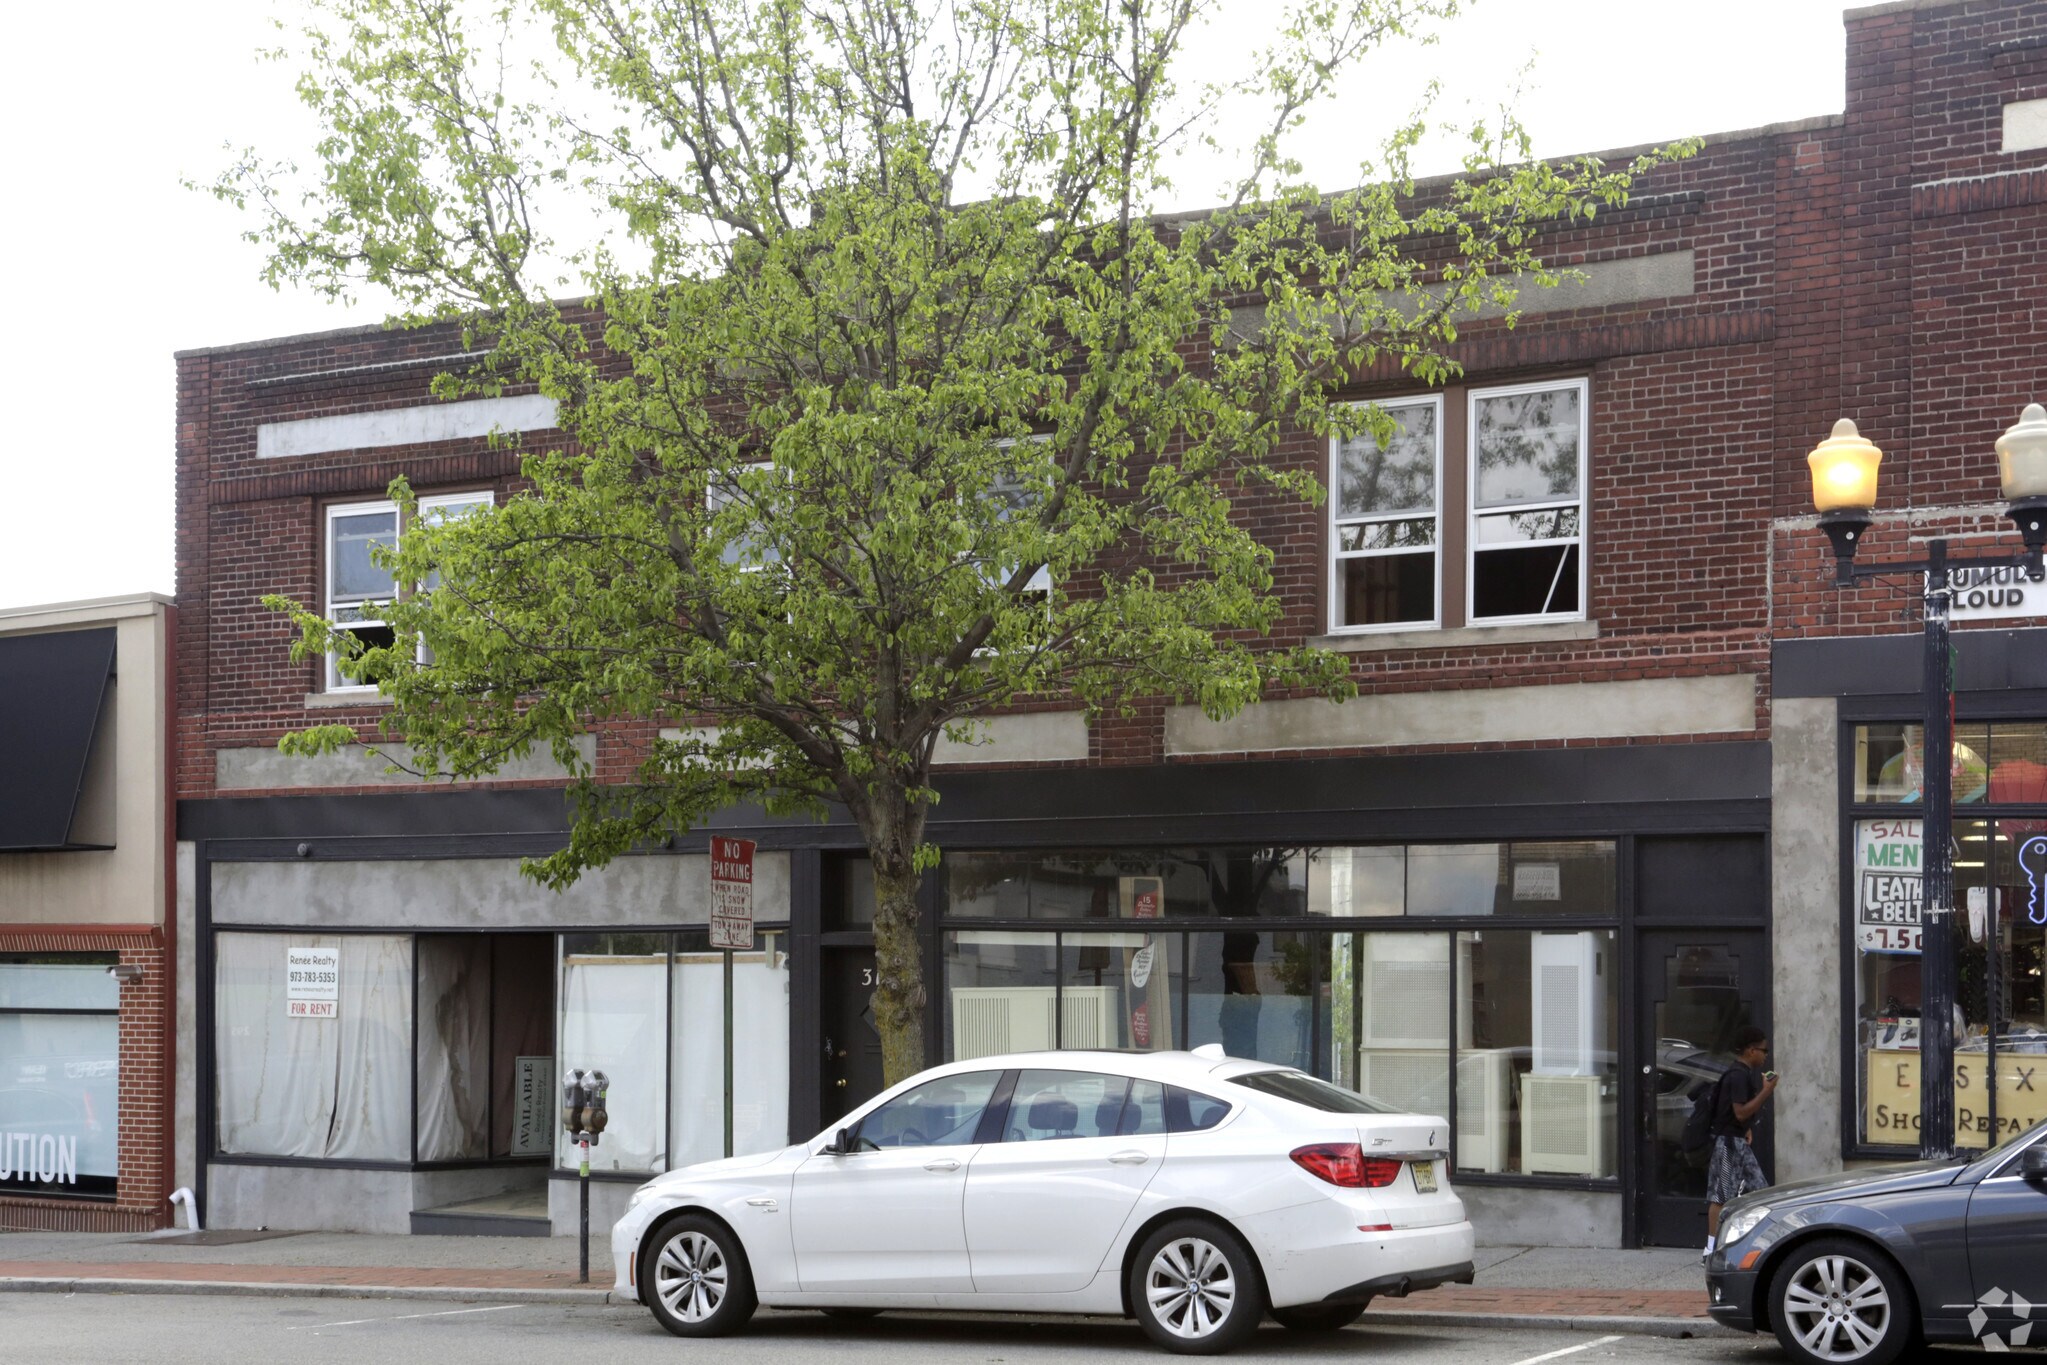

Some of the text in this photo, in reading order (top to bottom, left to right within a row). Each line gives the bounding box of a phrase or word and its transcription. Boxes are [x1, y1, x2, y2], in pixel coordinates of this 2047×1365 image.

[1871, 820, 1922, 840] SAL
[724, 841, 740, 860] NO
[713, 861, 750, 880] PARKING
[733, 885, 750, 895] ROAD
[1866, 876, 1922, 911] LEATH
[728, 895, 746, 905] SNOW
[1883, 900, 1922, 923] BELT
[312, 955, 337, 968] Realty
[289, 971, 336, 983] 973-783-5353
[291, 1002, 332, 1016] FOR RENT
[1897, 1063, 2035, 1092] ESX
[520, 1063, 533, 1148] AVAILABLE
[1875, 1104, 1921, 1130] SHO
